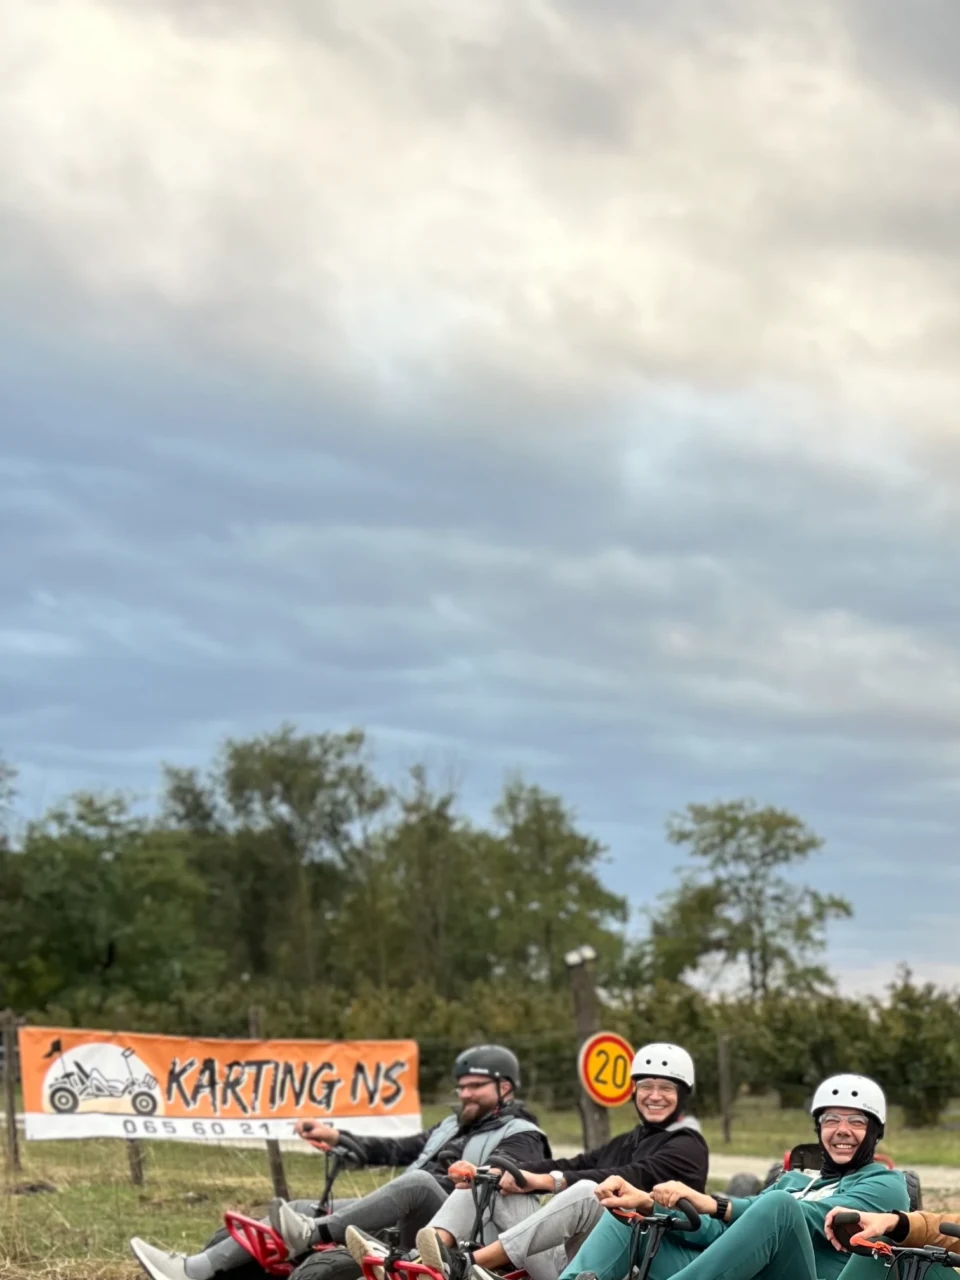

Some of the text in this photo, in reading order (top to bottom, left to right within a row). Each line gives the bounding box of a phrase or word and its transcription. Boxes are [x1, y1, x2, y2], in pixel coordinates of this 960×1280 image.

[165, 1056, 407, 1115] KARTING NS
[594, 1049, 627, 1089] 20
[123, 1119, 177, 1134] 065
[192, 1121, 225, 1136] 60
[239, 1122, 271, 1136] 21
